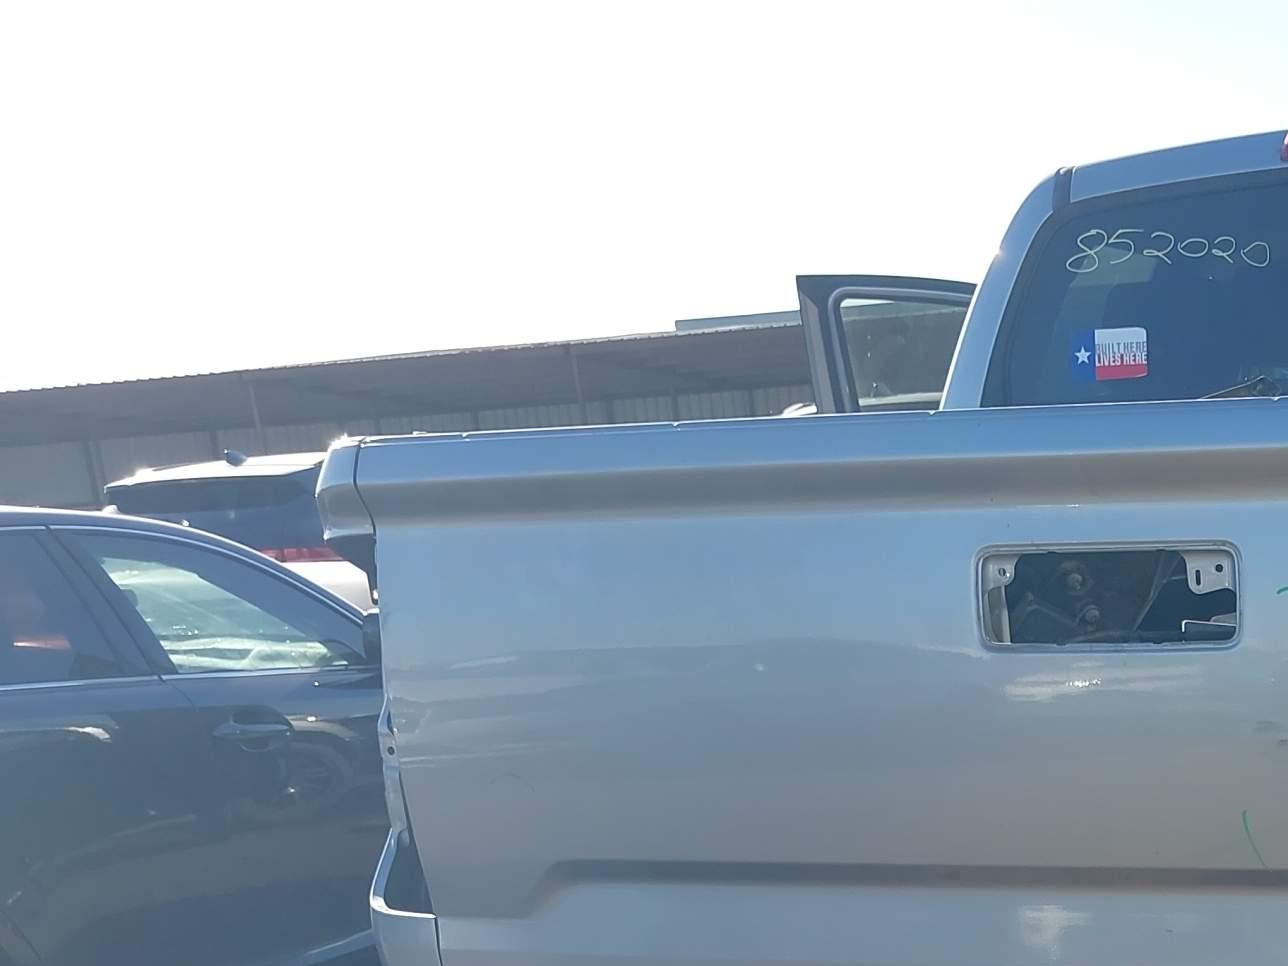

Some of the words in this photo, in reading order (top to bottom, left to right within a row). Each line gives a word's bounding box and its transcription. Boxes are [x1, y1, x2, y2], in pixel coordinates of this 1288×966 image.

[1066, 229, 1270, 272] 852020
[1096, 341, 1121, 356] BUILT
[1122, 340, 1147, 353] HERE
[1096, 352, 1121, 367] LIVES
[1123, 350, 1147, 365] HERE
